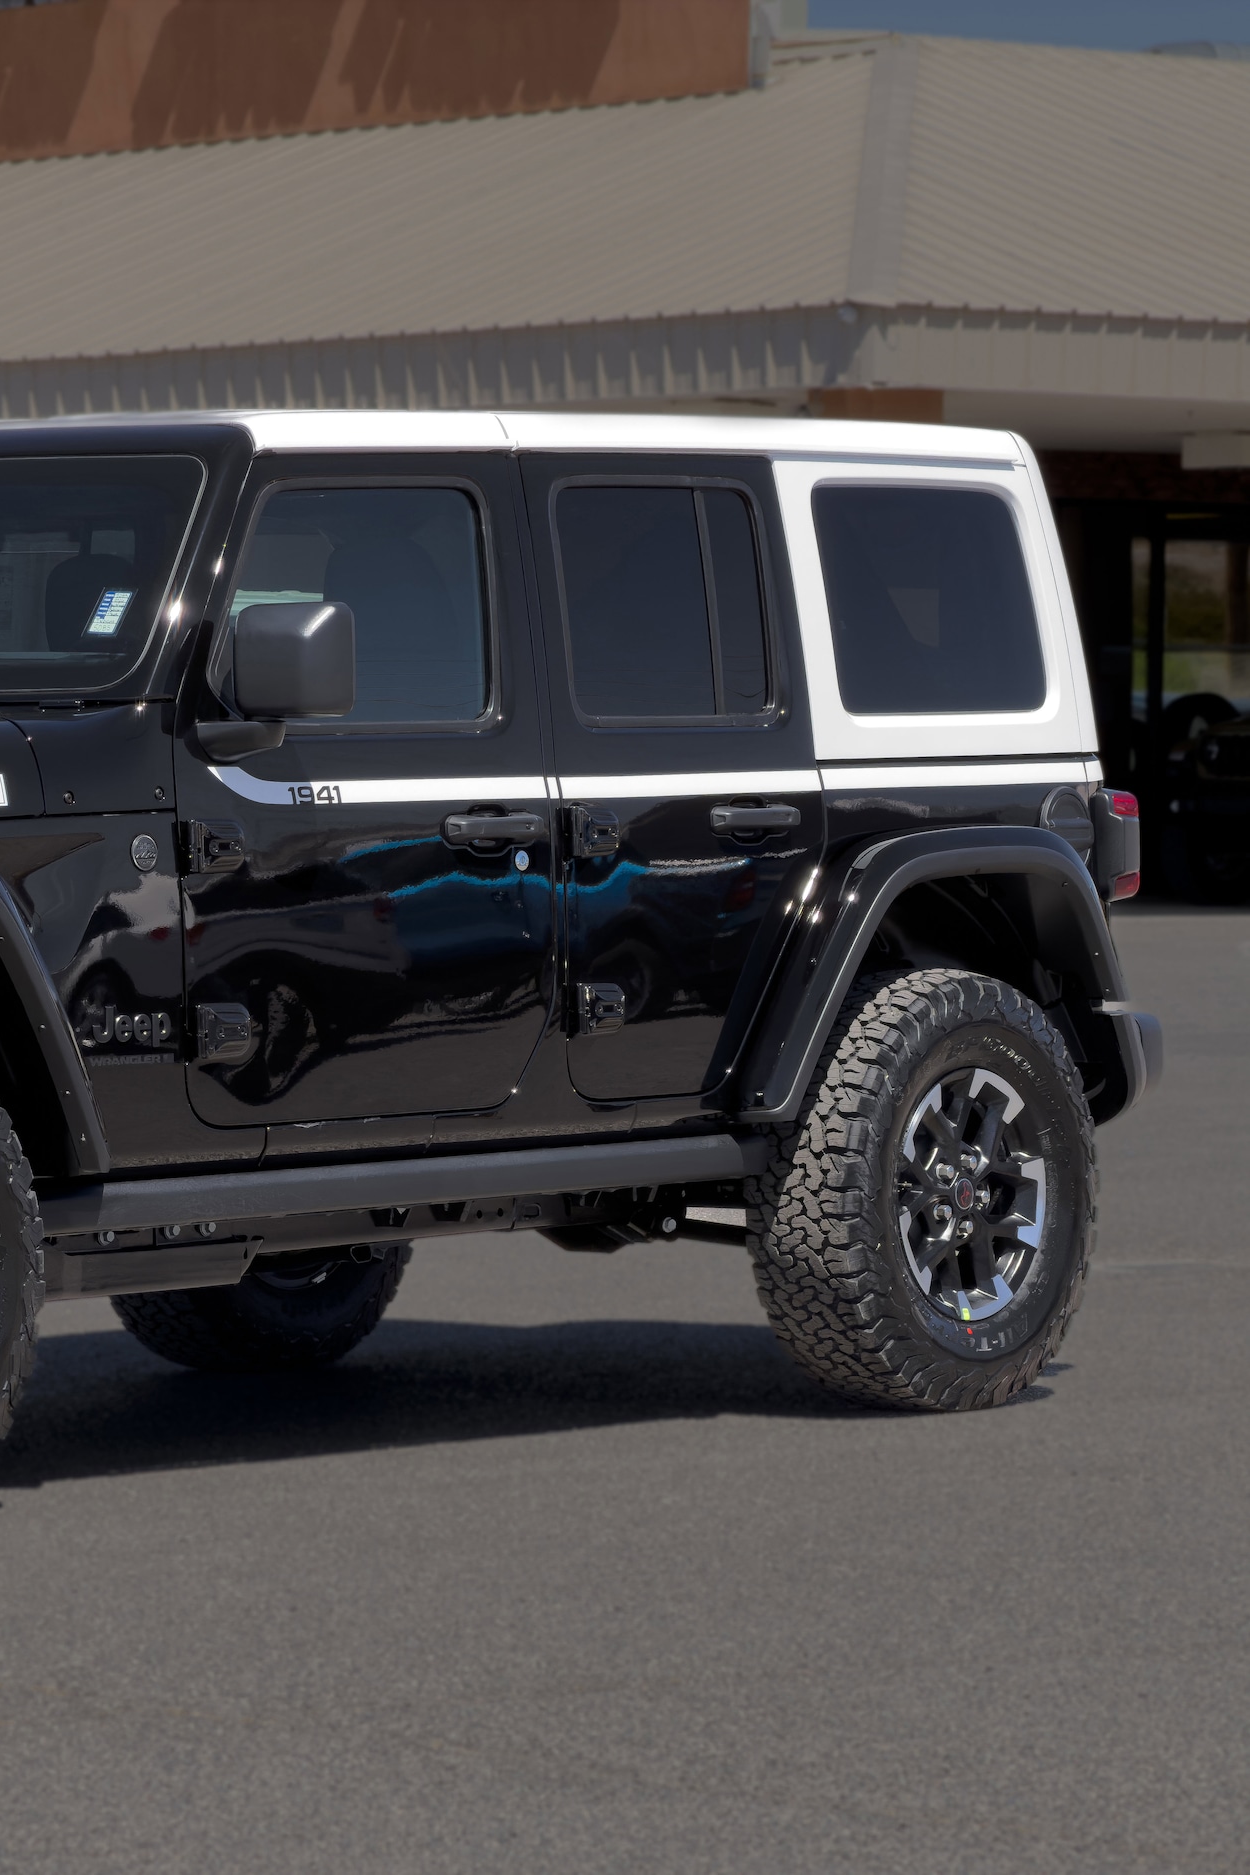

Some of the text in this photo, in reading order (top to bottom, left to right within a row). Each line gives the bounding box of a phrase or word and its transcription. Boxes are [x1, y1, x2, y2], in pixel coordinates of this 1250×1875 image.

[287, 785, 343, 805] 1941
[92, 1004, 172, 1048] Jeep
[90, 1054, 161, 1067] WRANGLER
